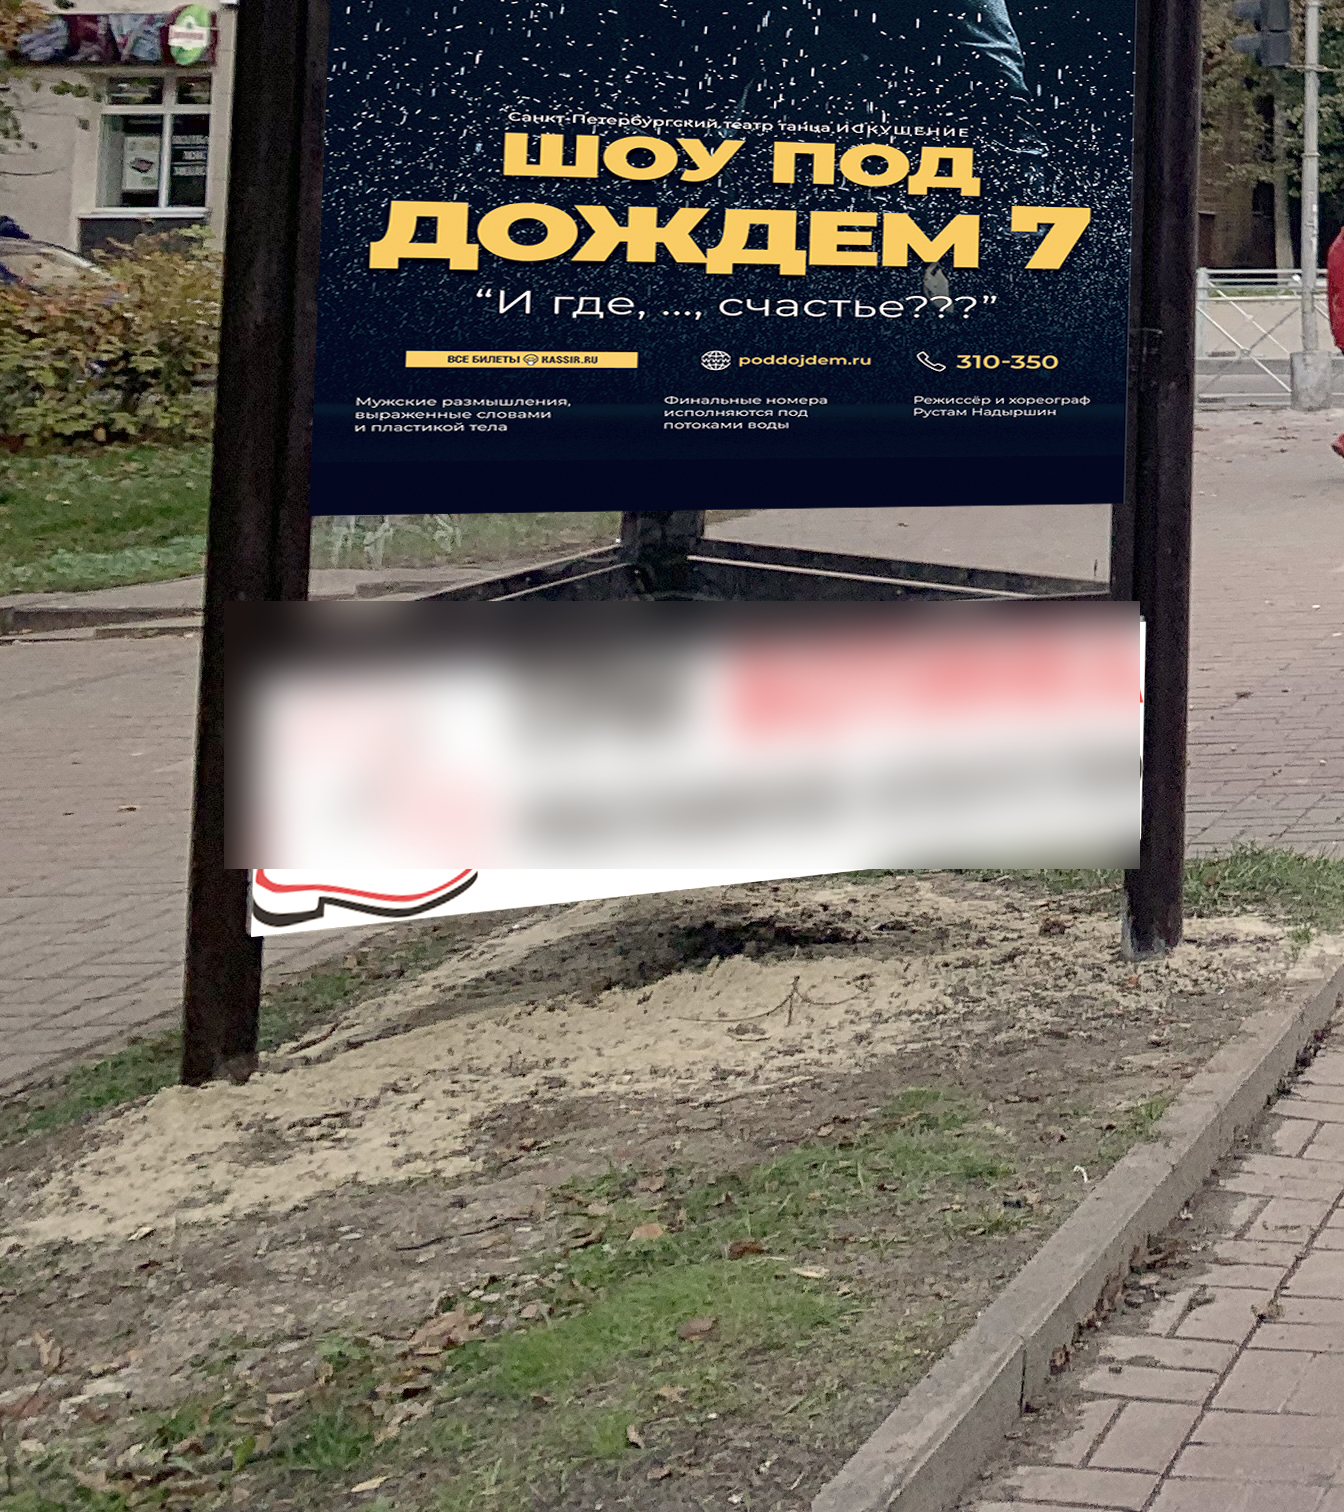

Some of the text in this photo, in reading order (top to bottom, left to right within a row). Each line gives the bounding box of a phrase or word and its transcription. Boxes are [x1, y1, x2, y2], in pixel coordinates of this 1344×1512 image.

[508, 111, 969, 138] Санкт-Петербургский театр танца ИСКУШЕНИЕ
[502, 132, 982, 197] ШОУ ПОД
[368, 200, 1092, 276] ДОЖДЕМ 7
[554, 295, 646, 319] где,
[447, 355, 520, 364] ВСЕ БИЛЕТЫ
[541, 355, 598, 364] KASSIR.RU
[739, 355, 871, 367] poddojdem.ru
[956, 355, 1059, 369] 310-350
[355, 397, 571, 408] Мужские размышления,
[664, 396, 828, 406] Финальные номера
[913, 396, 991, 406] Режиссёр
[1008, 396, 1091, 405] хореограф
[354, 411, 552, 421] выраженные словами
[663, 409, 808, 418] исполняются под
[913, 408, 1057, 418] Рустам Надыршин
[354, 422, 508, 432] и пластикой тела
[663, 421, 790, 430] потоками воды
